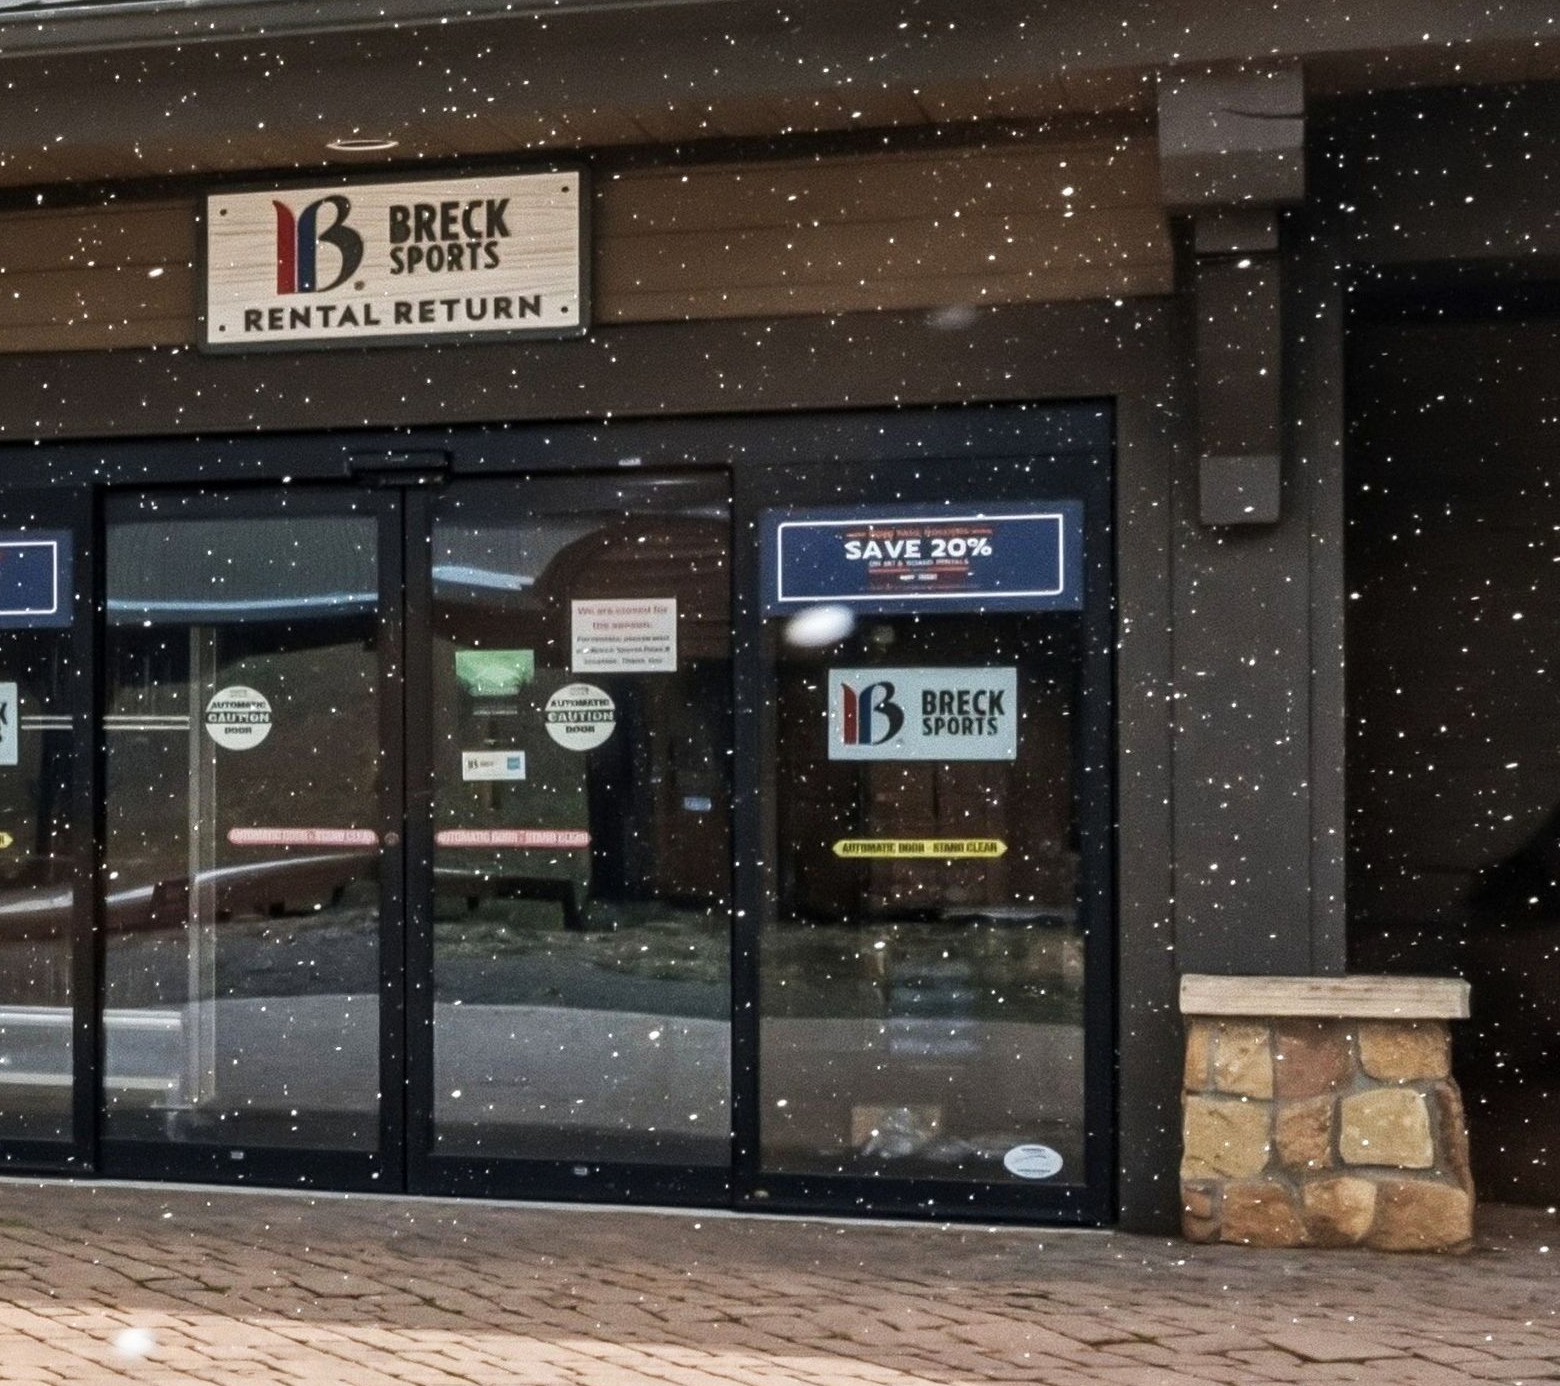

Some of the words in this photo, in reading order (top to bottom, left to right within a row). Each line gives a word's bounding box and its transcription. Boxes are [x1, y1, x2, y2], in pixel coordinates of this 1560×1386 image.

[389, 199, 511, 244] BRECK
[389, 241, 500, 275] SPORTS
[244, 303, 380, 332] RENTAL
[395, 295, 542, 325] RETURN
[844, 540, 921, 560] SAVE
[931, 538, 992, 557] 20%
[211, 701, 266, 709] AUTOMATIC
[551, 699, 610, 707] AUTOMATIC
[922, 690, 1005, 716] BRECK
[208, 712, 269, 723] CAUTION
[547, 711, 614, 722] CAUTION
[566, 725, 595, 733] DOOR
[922, 717, 998, 736] SPORTS
